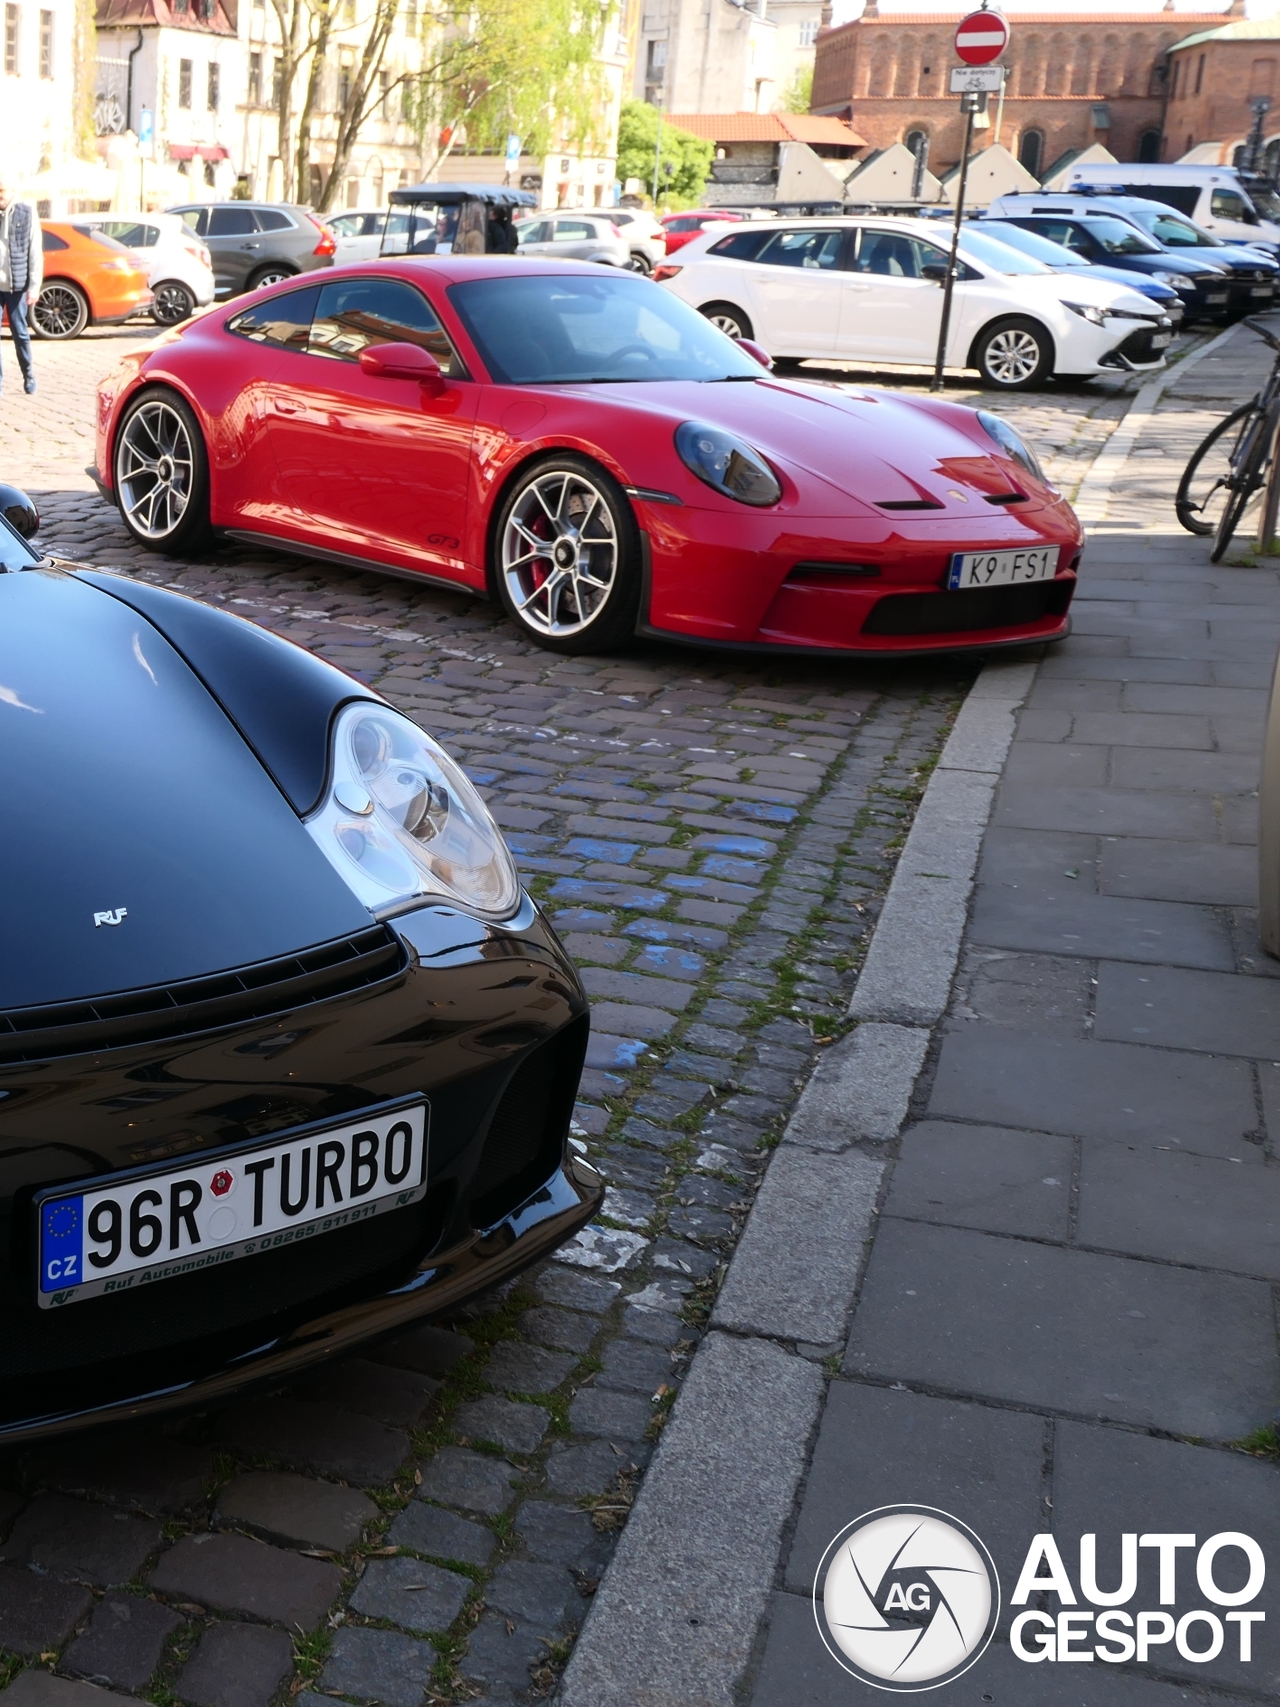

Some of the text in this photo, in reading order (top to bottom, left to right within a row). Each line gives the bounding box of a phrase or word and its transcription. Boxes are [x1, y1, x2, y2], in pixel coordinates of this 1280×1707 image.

[427, 533, 460, 549] GT3
[970, 552, 1048, 584] K9 FS1
[93, 907, 128, 927] RUF
[87, 1120, 413, 1268] 96R TURBO
[103, 1275, 135, 1292] Ruf
[139, 1249, 235, 1283] Automobile
[351, 1204, 377, 1221] 911
[47, 1255, 77, 1280] CZ
